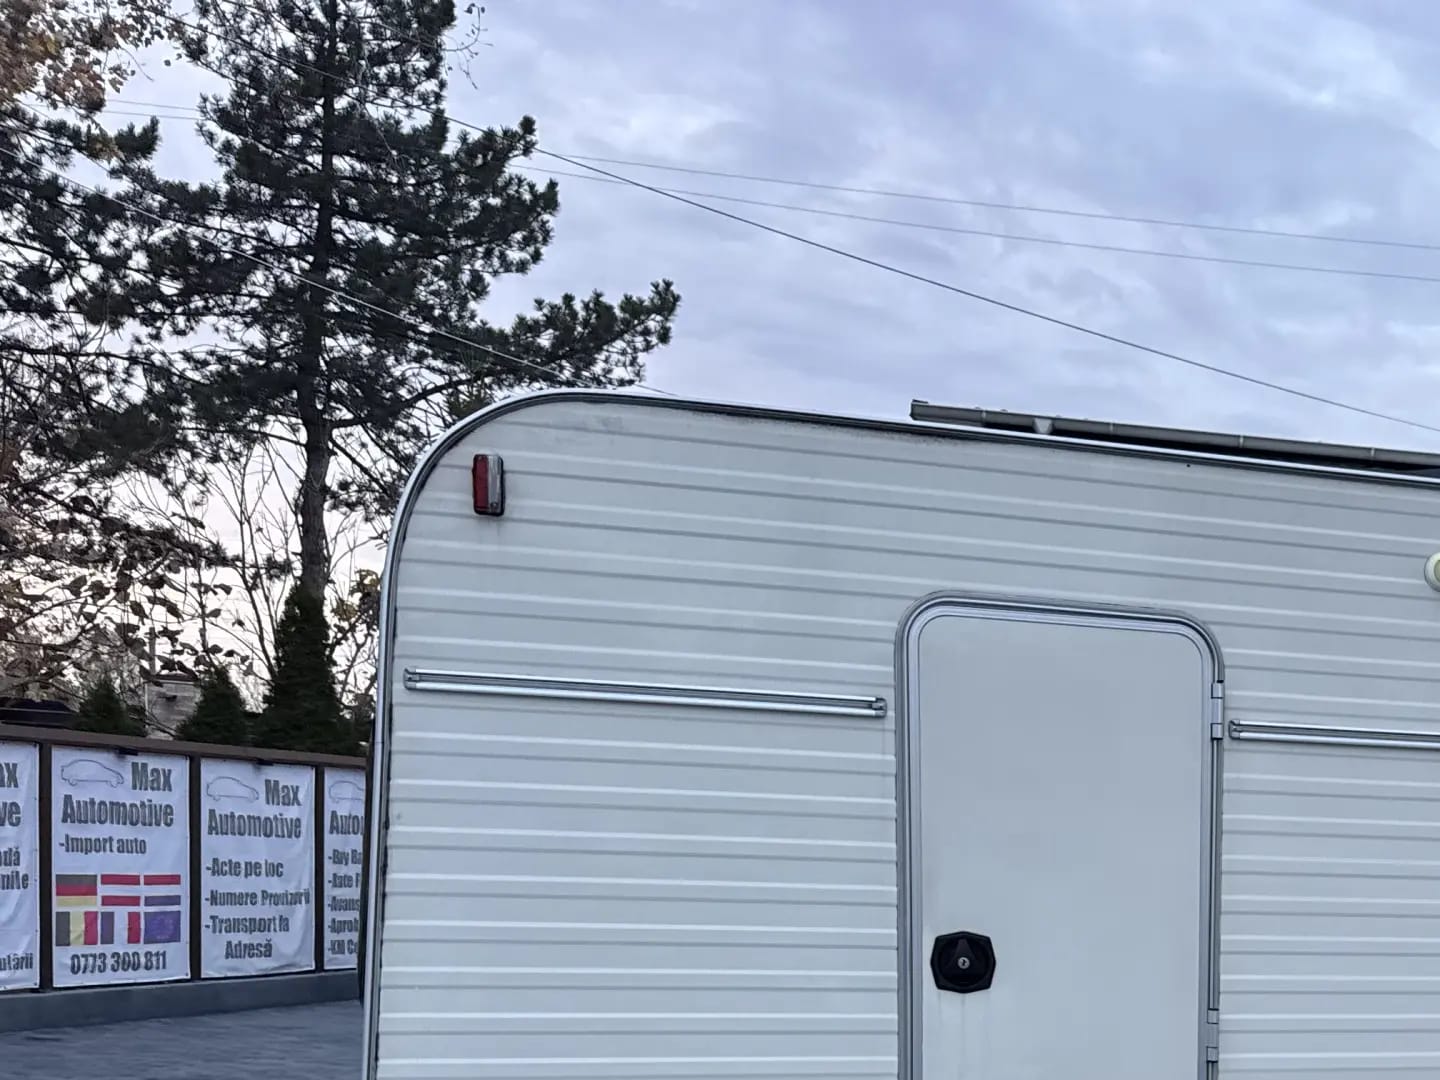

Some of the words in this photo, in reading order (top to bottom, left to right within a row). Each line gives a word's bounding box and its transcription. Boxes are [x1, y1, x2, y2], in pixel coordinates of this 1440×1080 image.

[131, 762, 172, 792] Max
[264, 779, 302, 807] Max
[61, 794, 174, 828] Automotive
[207, 808, 302, 839] Automotive
[59, 834, 114, 855] -Import
[116, 838, 147, 854] auto
[205, 857, 241, 877] -Acte
[244, 861, 262, 879] pe
[264, 859, 284, 878] loc
[205, 889, 258, 906] -Numere
[204, 915, 277, 935] -Transport
[279, 914, 290, 933] la
[224, 938, 273, 960] Adresă
[70, 952, 107, 975] 0773
[110, 951, 141, 973] 300
[143, 950, 167, 971] 811
